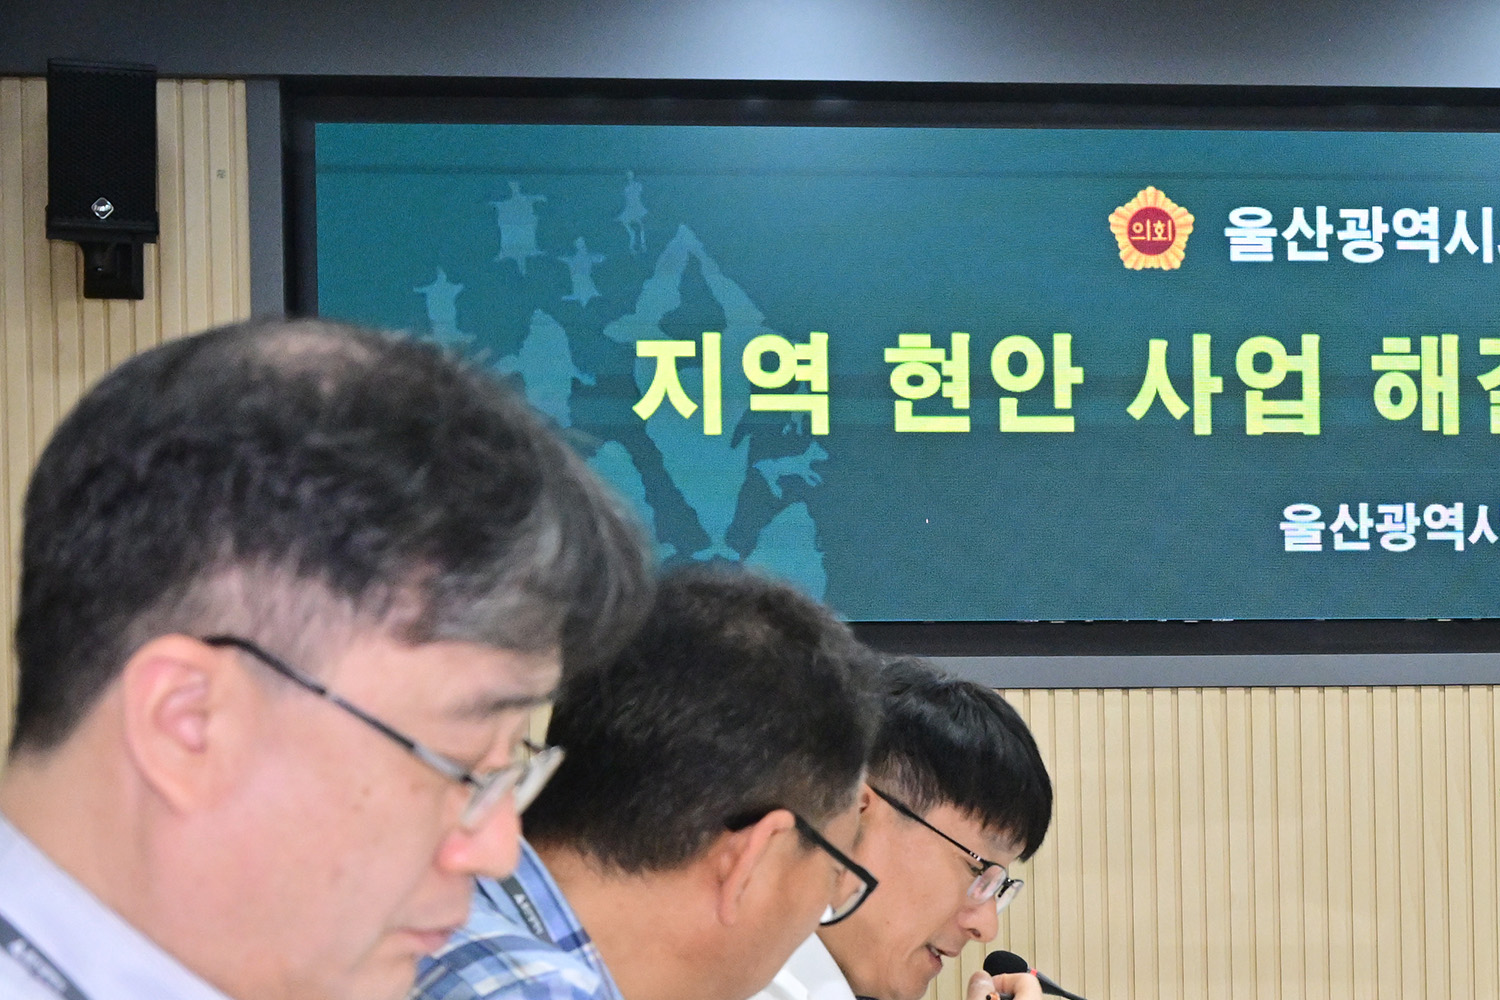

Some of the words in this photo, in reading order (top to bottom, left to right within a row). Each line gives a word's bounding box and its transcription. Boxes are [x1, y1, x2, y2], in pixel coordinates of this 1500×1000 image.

[1129, 218, 1173, 242] 의회
[631, 332, 830, 437] 지역
[883, 332, 1085, 434] 현안
[1126, 333, 1322, 437] 사업
